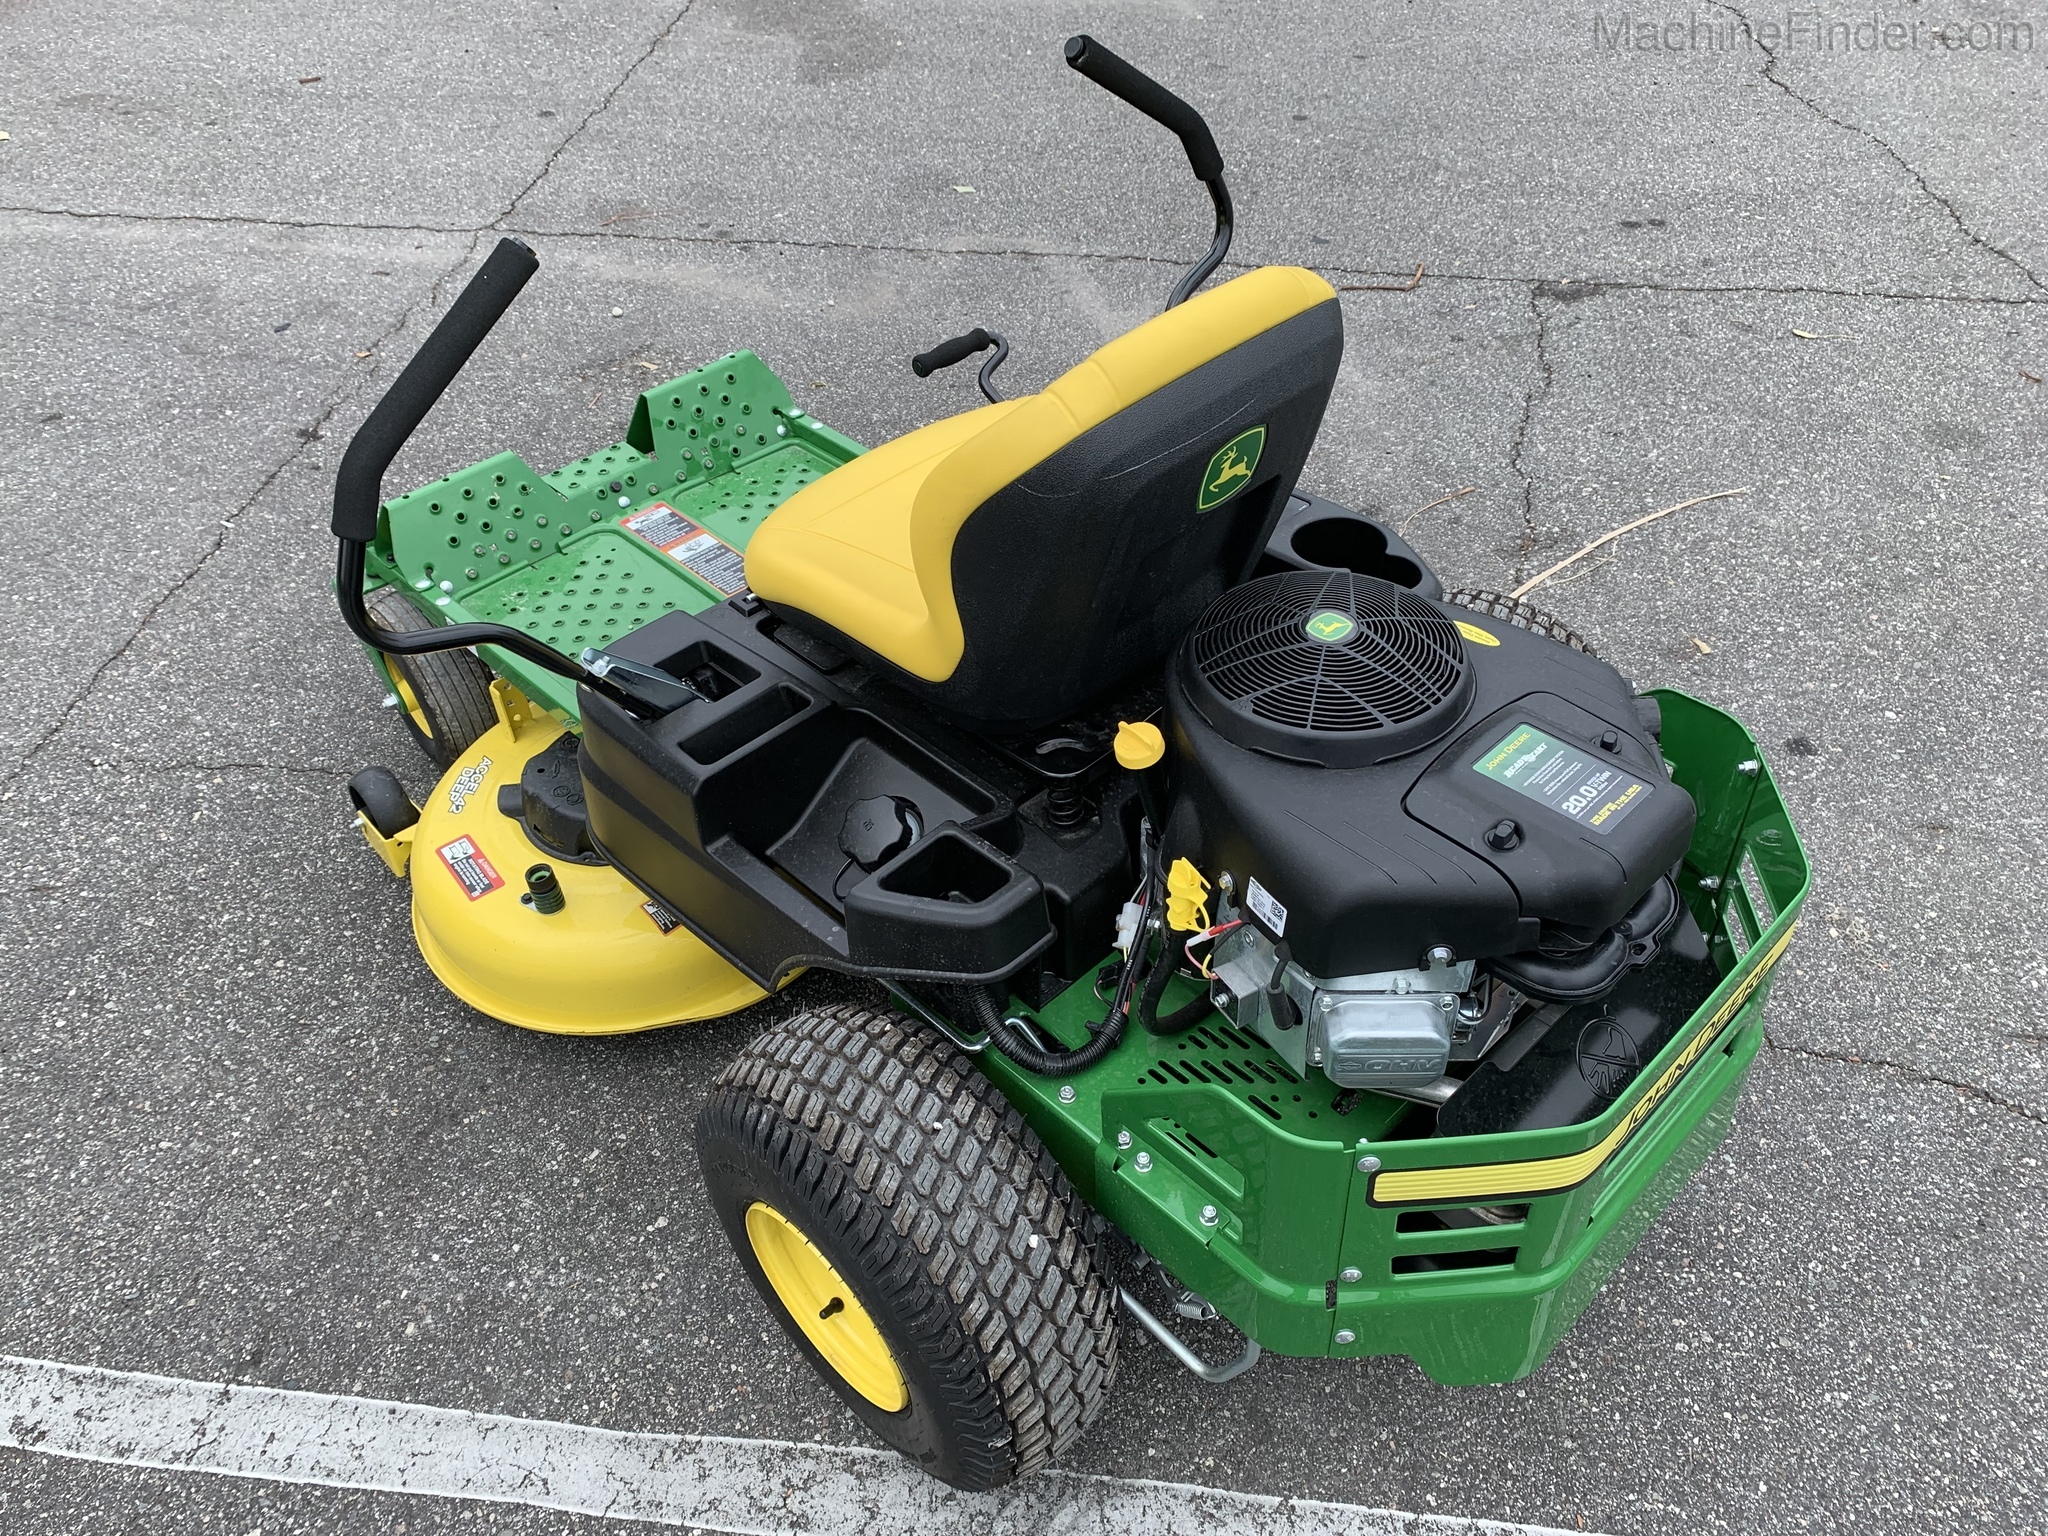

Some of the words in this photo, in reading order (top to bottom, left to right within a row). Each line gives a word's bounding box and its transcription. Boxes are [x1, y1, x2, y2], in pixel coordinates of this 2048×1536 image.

[1486, 752, 1507, 770] JOHN
[1504, 732, 1531, 753] DEERE
[448, 767, 475, 800] DEEP
[461, 755, 493, 797] ACCEL
[448, 797, 466, 813] 42
[1562, 785, 1598, 815] 20.0
[1614, 795, 1627, 807] THE
[480, 861, 497, 879] DANGER
[1616, 1051, 1691, 1147] JOHN
[1692, 954, 1774, 1057] DEERE
